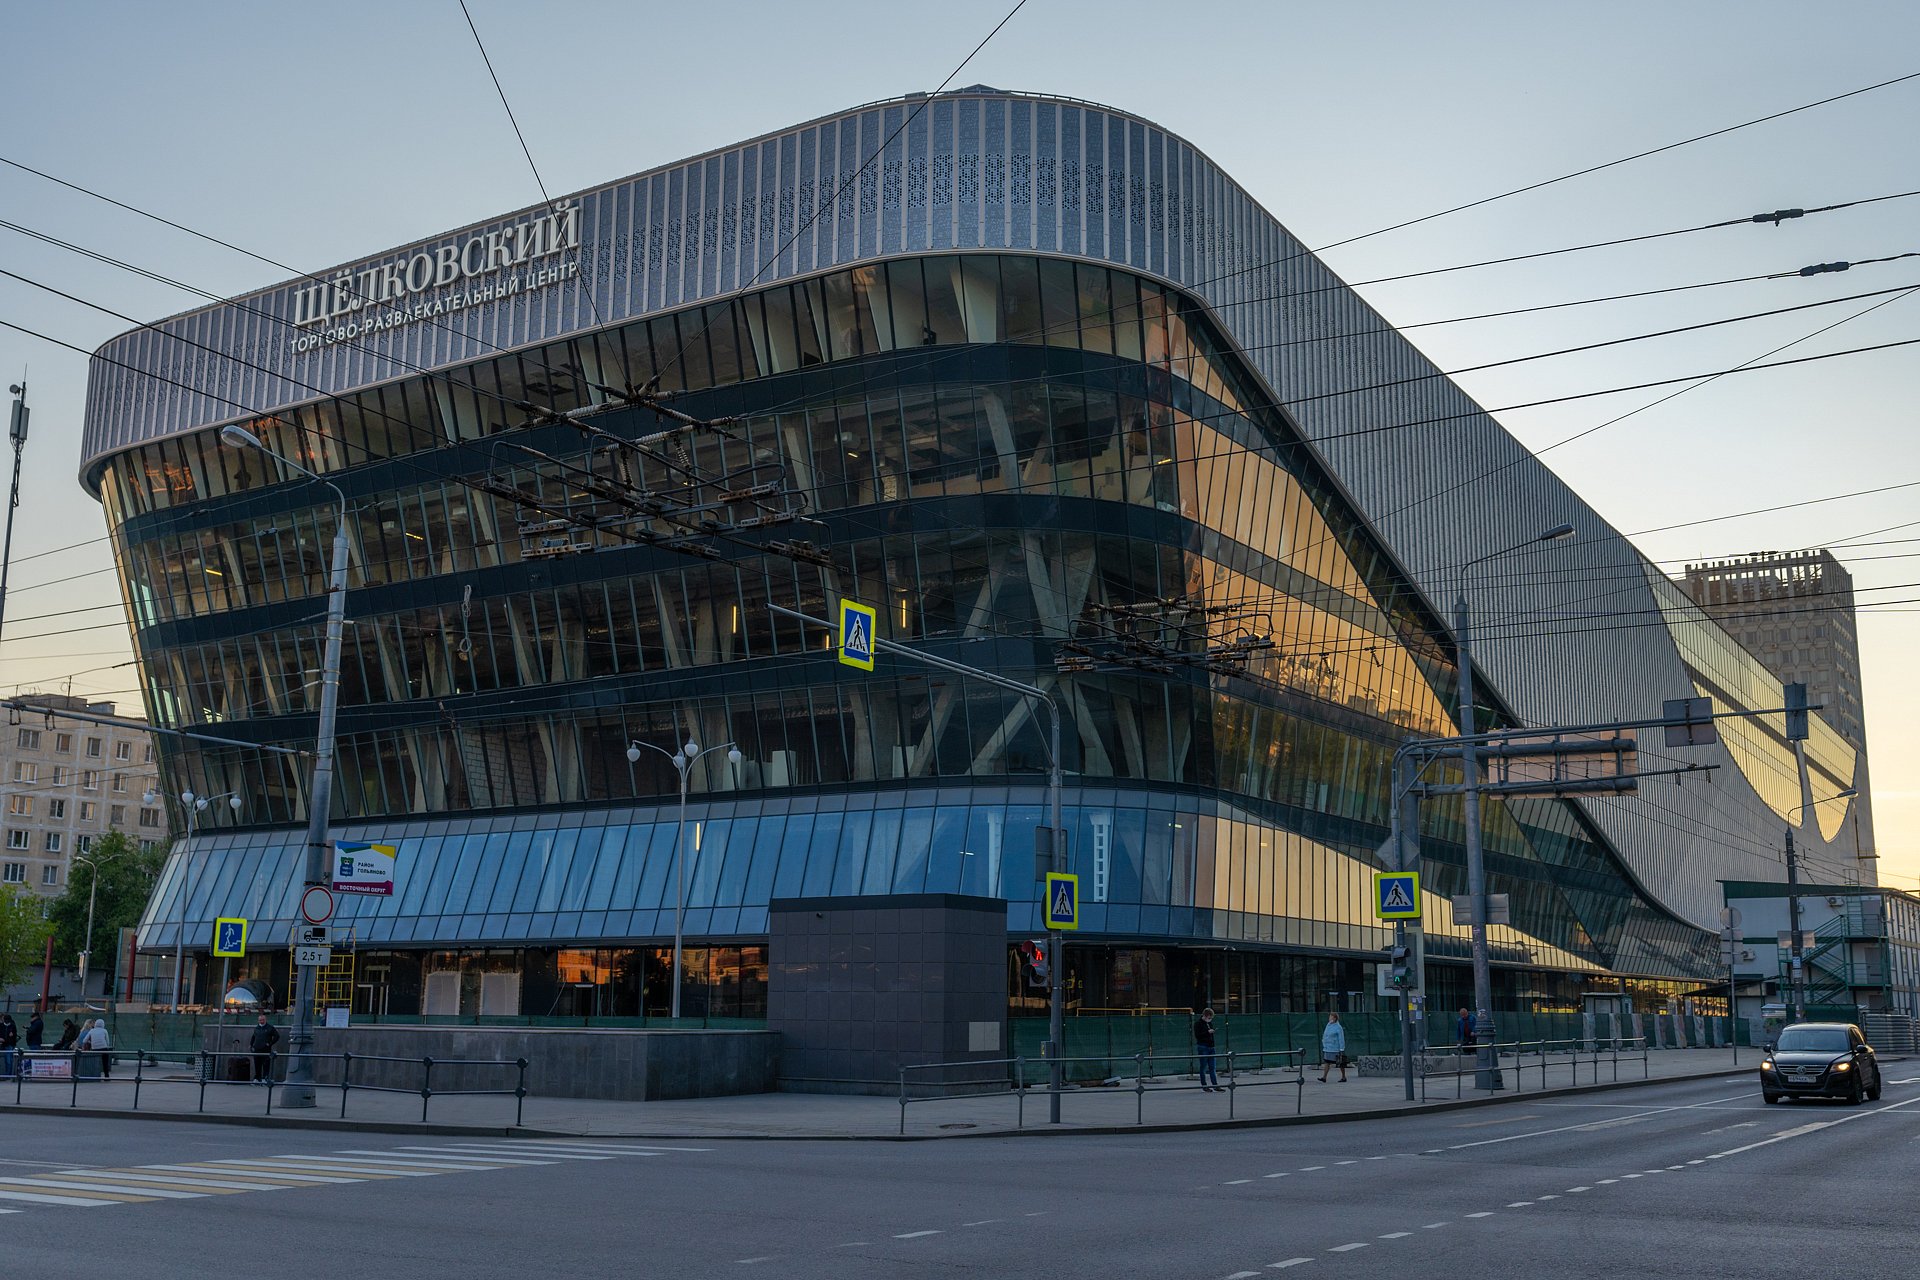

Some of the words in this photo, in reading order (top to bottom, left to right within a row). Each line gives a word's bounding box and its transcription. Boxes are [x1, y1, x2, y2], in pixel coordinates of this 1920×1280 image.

[291, 276, 519, 353] ТОРГОВО-РАЗВЛЕКАТЕЛЬНЫЙ
[526, 262, 578, 290] ЦЕНТР
[292, 199, 579, 327] ЩЁЛКОВСКИЙ
[302, 952, 315, 962] 2,5
